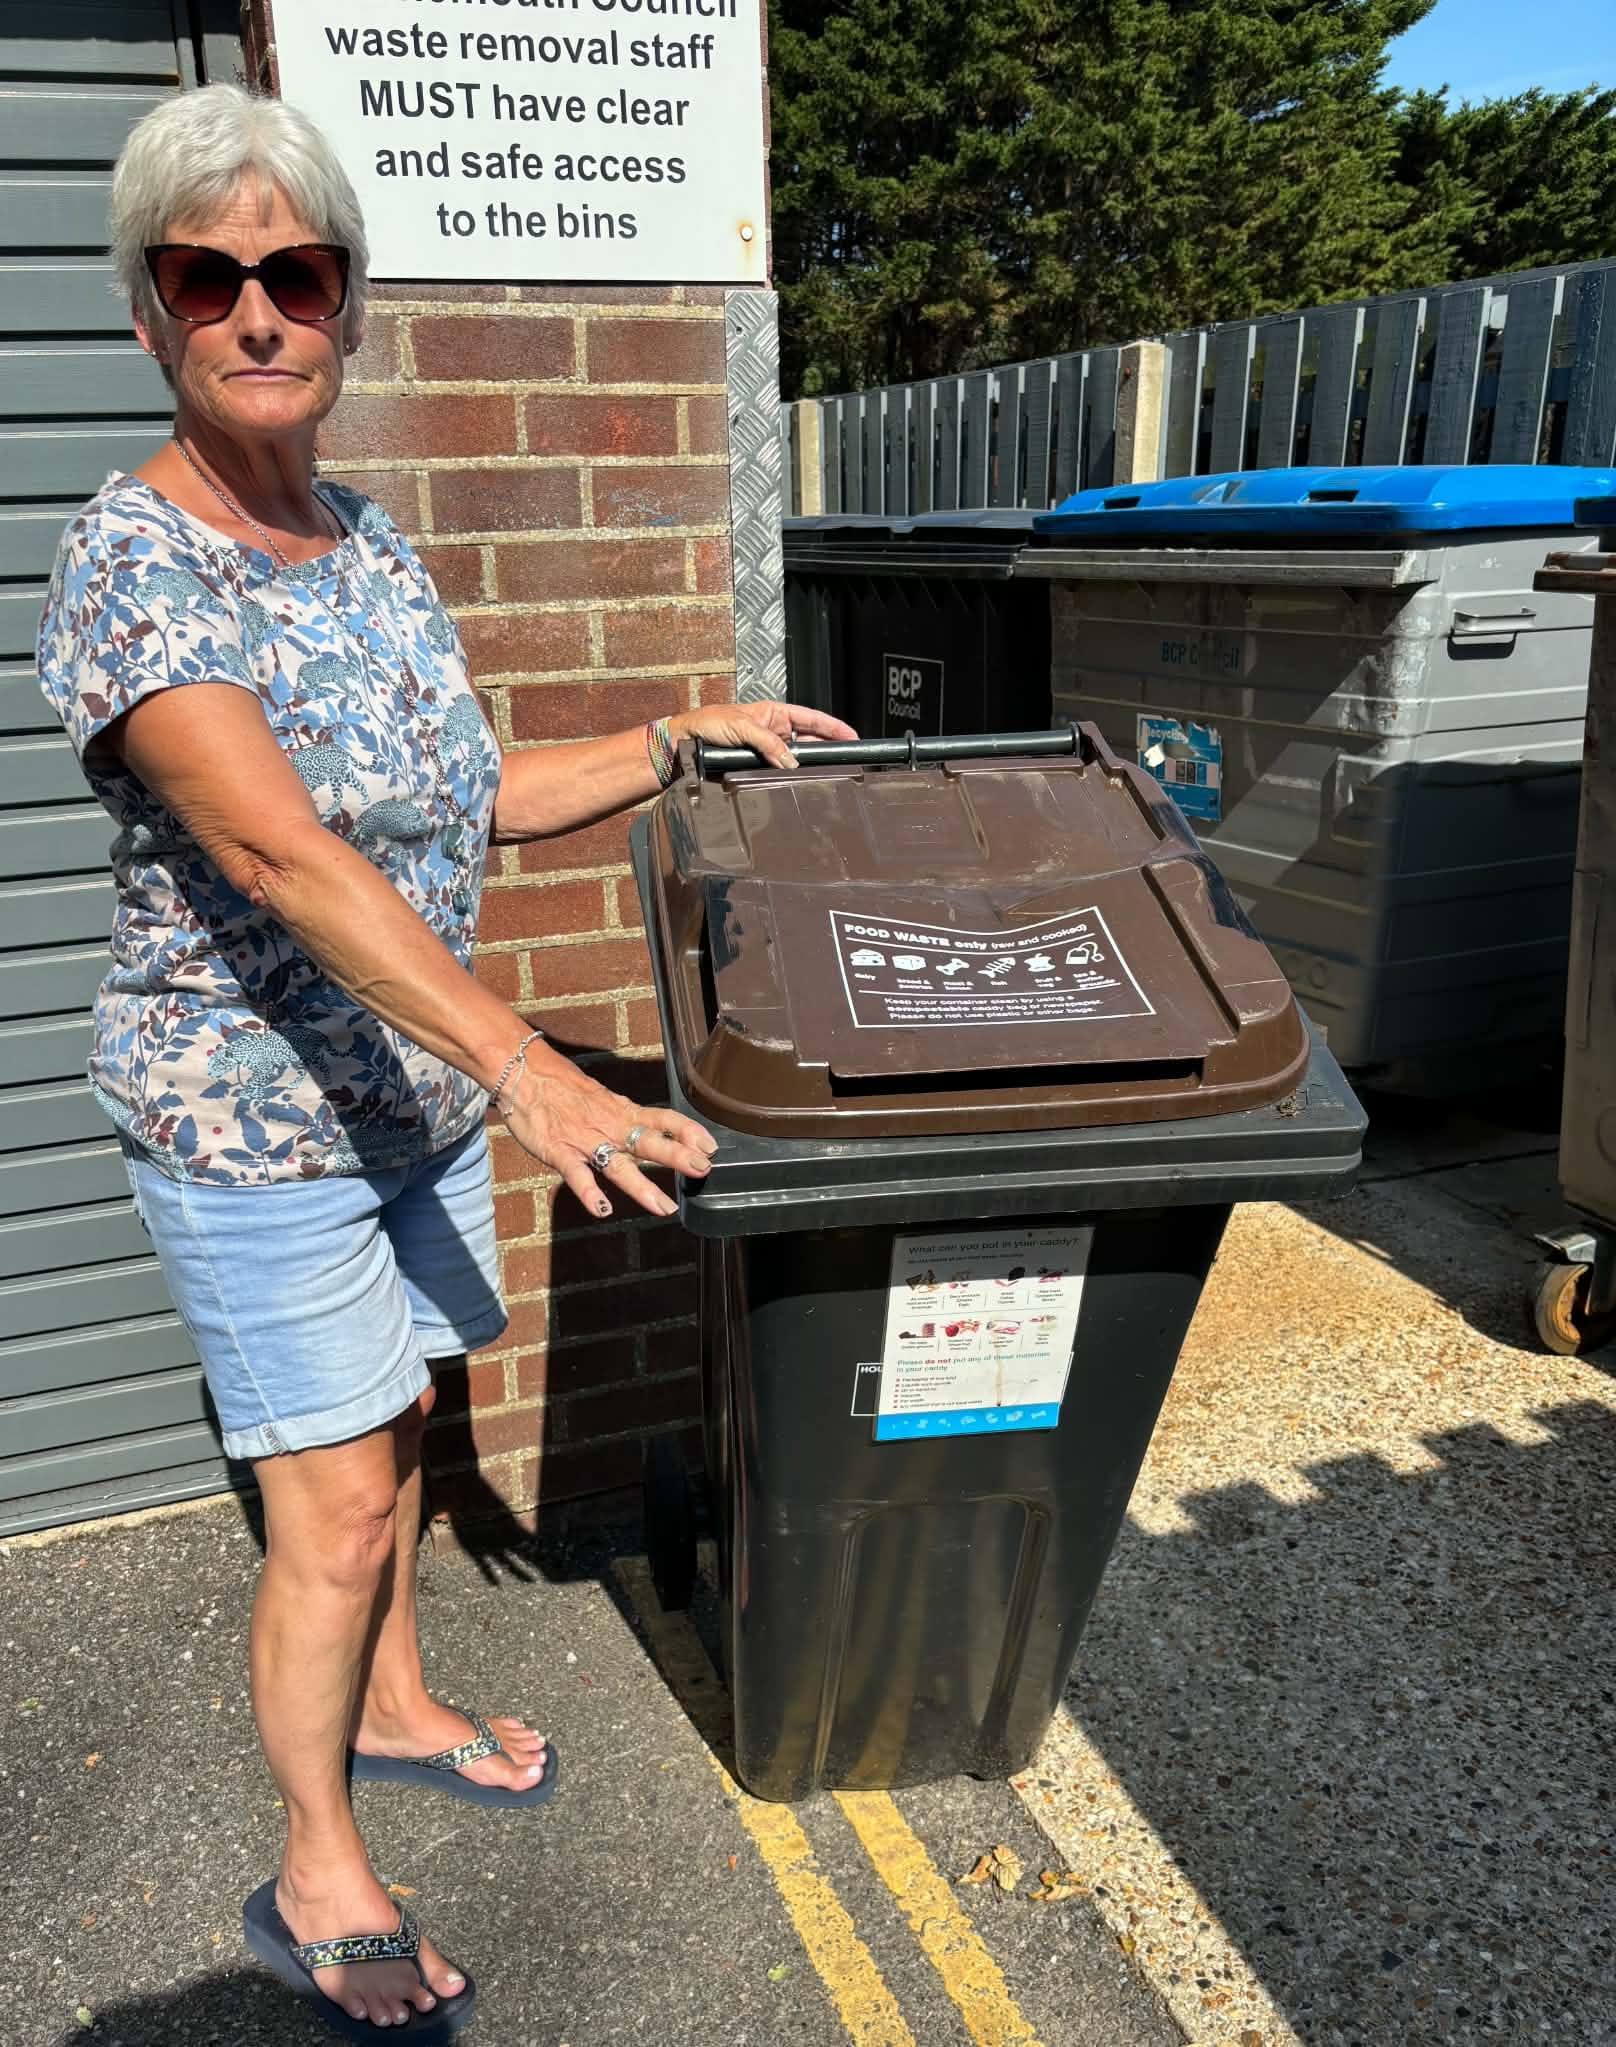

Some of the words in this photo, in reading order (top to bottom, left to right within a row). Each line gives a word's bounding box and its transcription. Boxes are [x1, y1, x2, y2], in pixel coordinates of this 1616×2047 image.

[325, 24, 448, 59] waste
[460, 30, 618, 66] removal
[630, 34, 714, 70] staff
[360, 79, 480, 119] MUST
[492, 84, 586, 123] have
[596, 89, 690, 126] clear
[375, 142, 449, 178] and
[461, 143, 543, 180] safe
[554, 153, 686, 184] access
[437, 202, 476, 237] to
[485, 202, 547, 238] the
[557, 203, 638, 240] bins
[1161, 640, 1187, 665] BCP
[1189, 643, 1240, 672] Ccil
[888, 666, 922, 699] BCP
[887, 697, 921, 720] Council
[844, 923, 890, 938] FOOD
[893, 931, 951, 946] WASTE
[954, 940, 987, 951] only
[991, 941, 1015, 950] (raw
[1018, 936, 1039, 946] and
[1041, 923, 1087, 941] cooked)
[884, 997, 912, 1005] Keep
[908, 1245, 936, 1255] What
[938, 1244, 958, 1253] can
[960, 1242, 979, 1253] you
[982, 1240, 1000, 1250] put
[1002, 1240, 1012, 1248] in
[1013, 1239, 1036, 1249] your
[1039, 1236, 1081, 1249] caddy?
[937, 1357, 952, 1365] not
